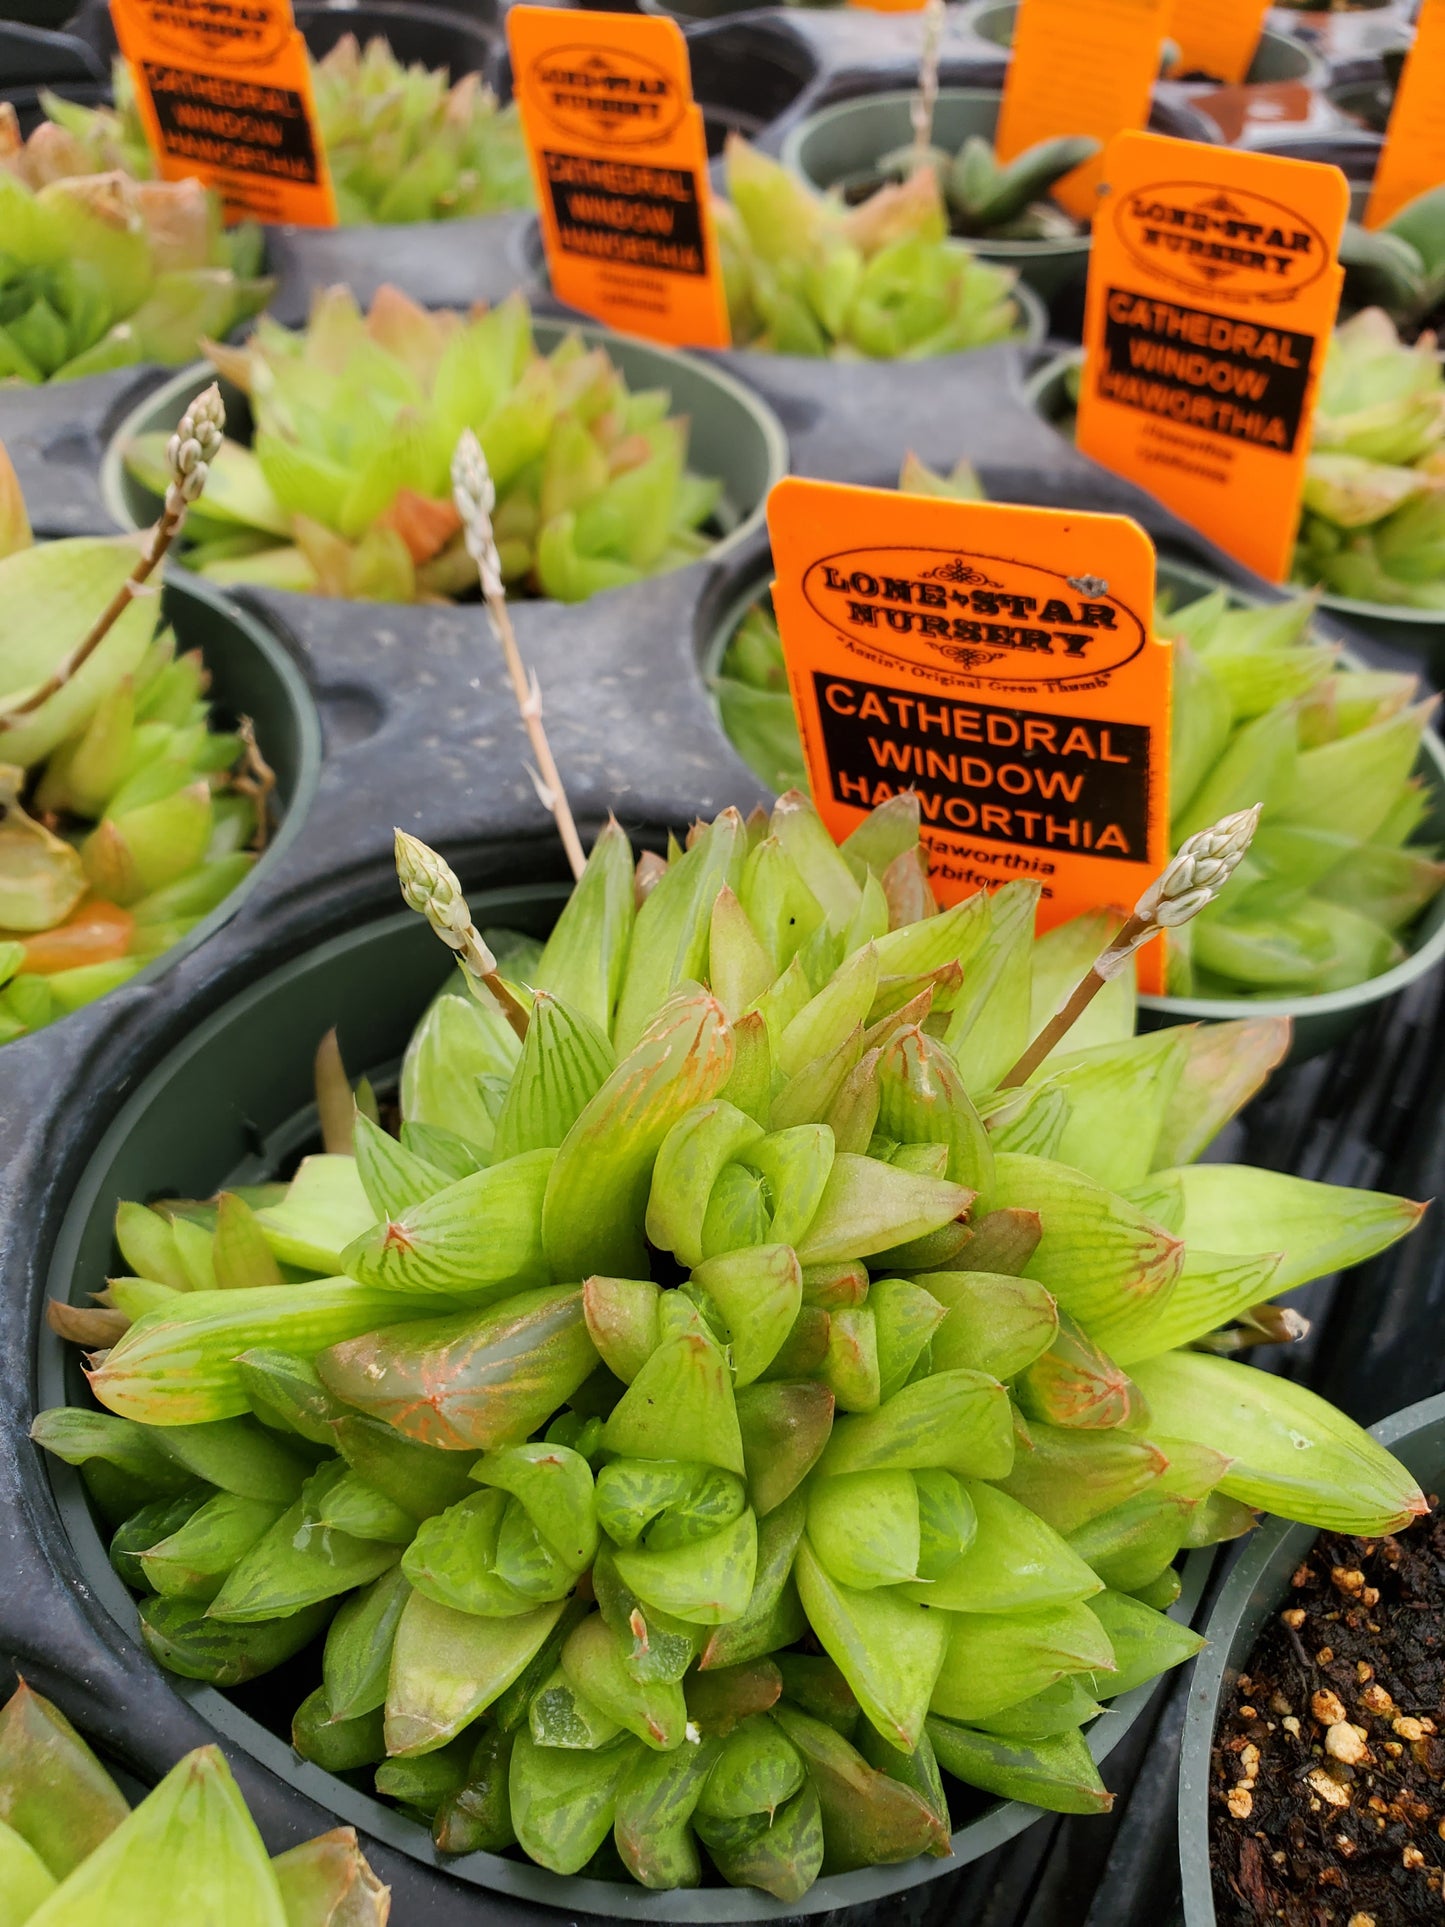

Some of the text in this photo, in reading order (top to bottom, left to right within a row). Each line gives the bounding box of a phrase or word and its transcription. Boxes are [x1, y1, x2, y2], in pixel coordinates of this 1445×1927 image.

[1108, 291, 1300, 369] CATHEDRAL
[1129, 337, 1271, 401] WINDOW
[1100, 371, 1287, 448] HAWORTHIA
[821, 566, 1118, 630] LONE STAR
[846, 600, 1094, 658] NURSERY
[911, 666, 981, 690] Original
[824, 683, 1131, 765] CATHEDRAL
[867, 736, 1086, 804] WINDOW
[838, 770, 1131, 854] HAWORTHIA
